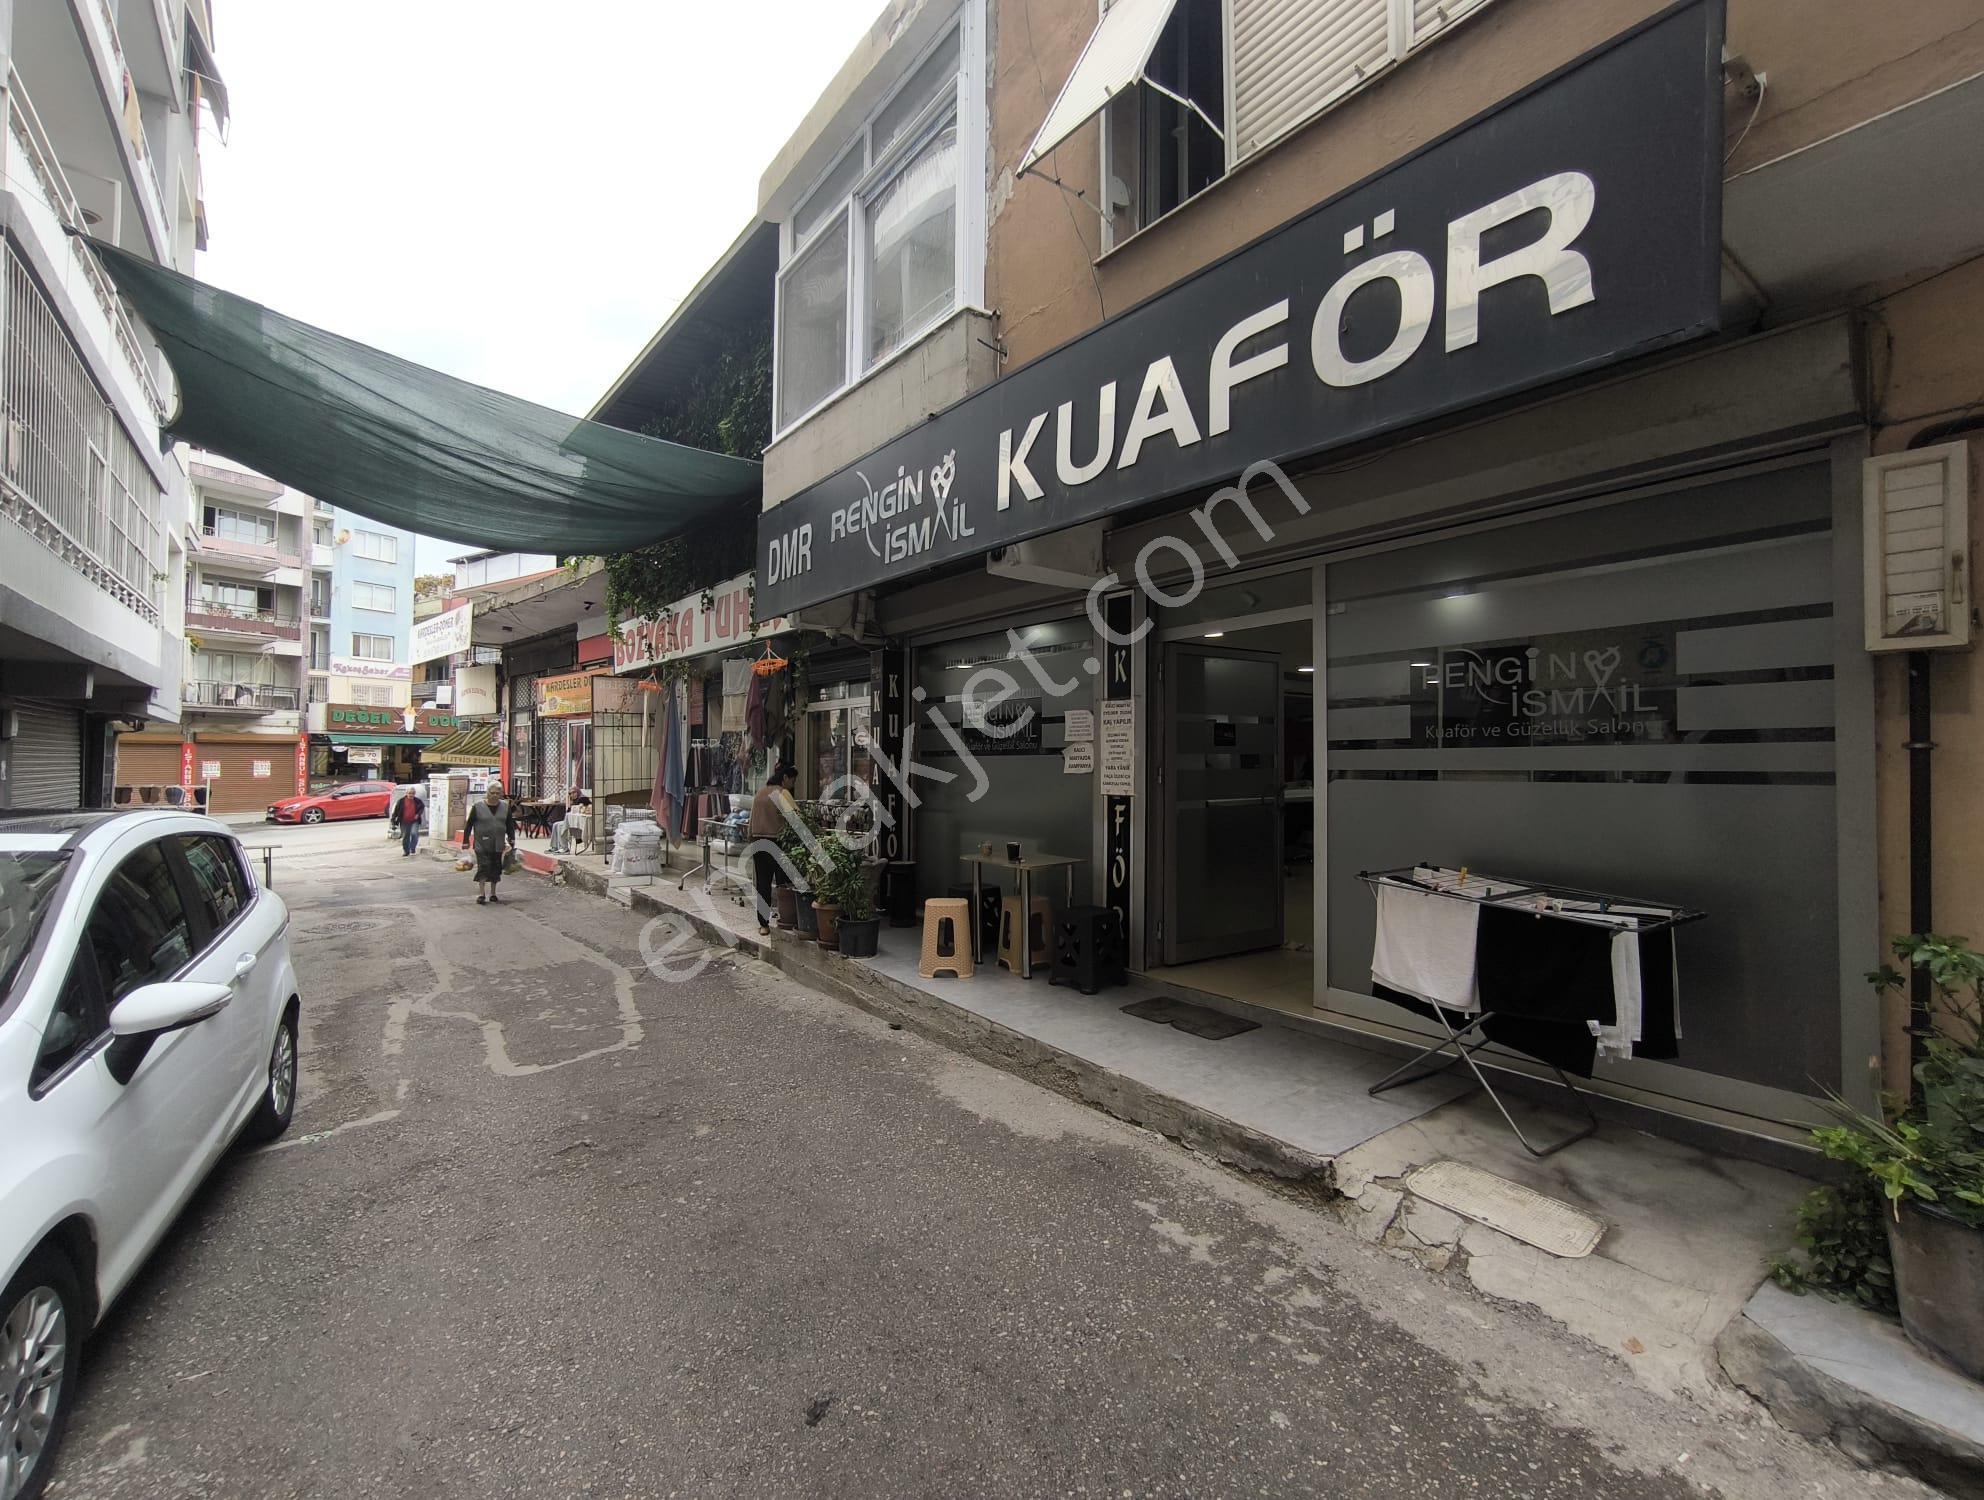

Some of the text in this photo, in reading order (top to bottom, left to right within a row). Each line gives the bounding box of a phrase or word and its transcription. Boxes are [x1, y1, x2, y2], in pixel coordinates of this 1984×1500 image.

[997, 171, 1596, 512] KUAFÖR
[767, 523, 813, 587] DMR
[1425, 724, 1477, 739] Kuaför
[1482, 726, 1500, 737] ve
[1507, 720, 1580, 738] Güzellik
